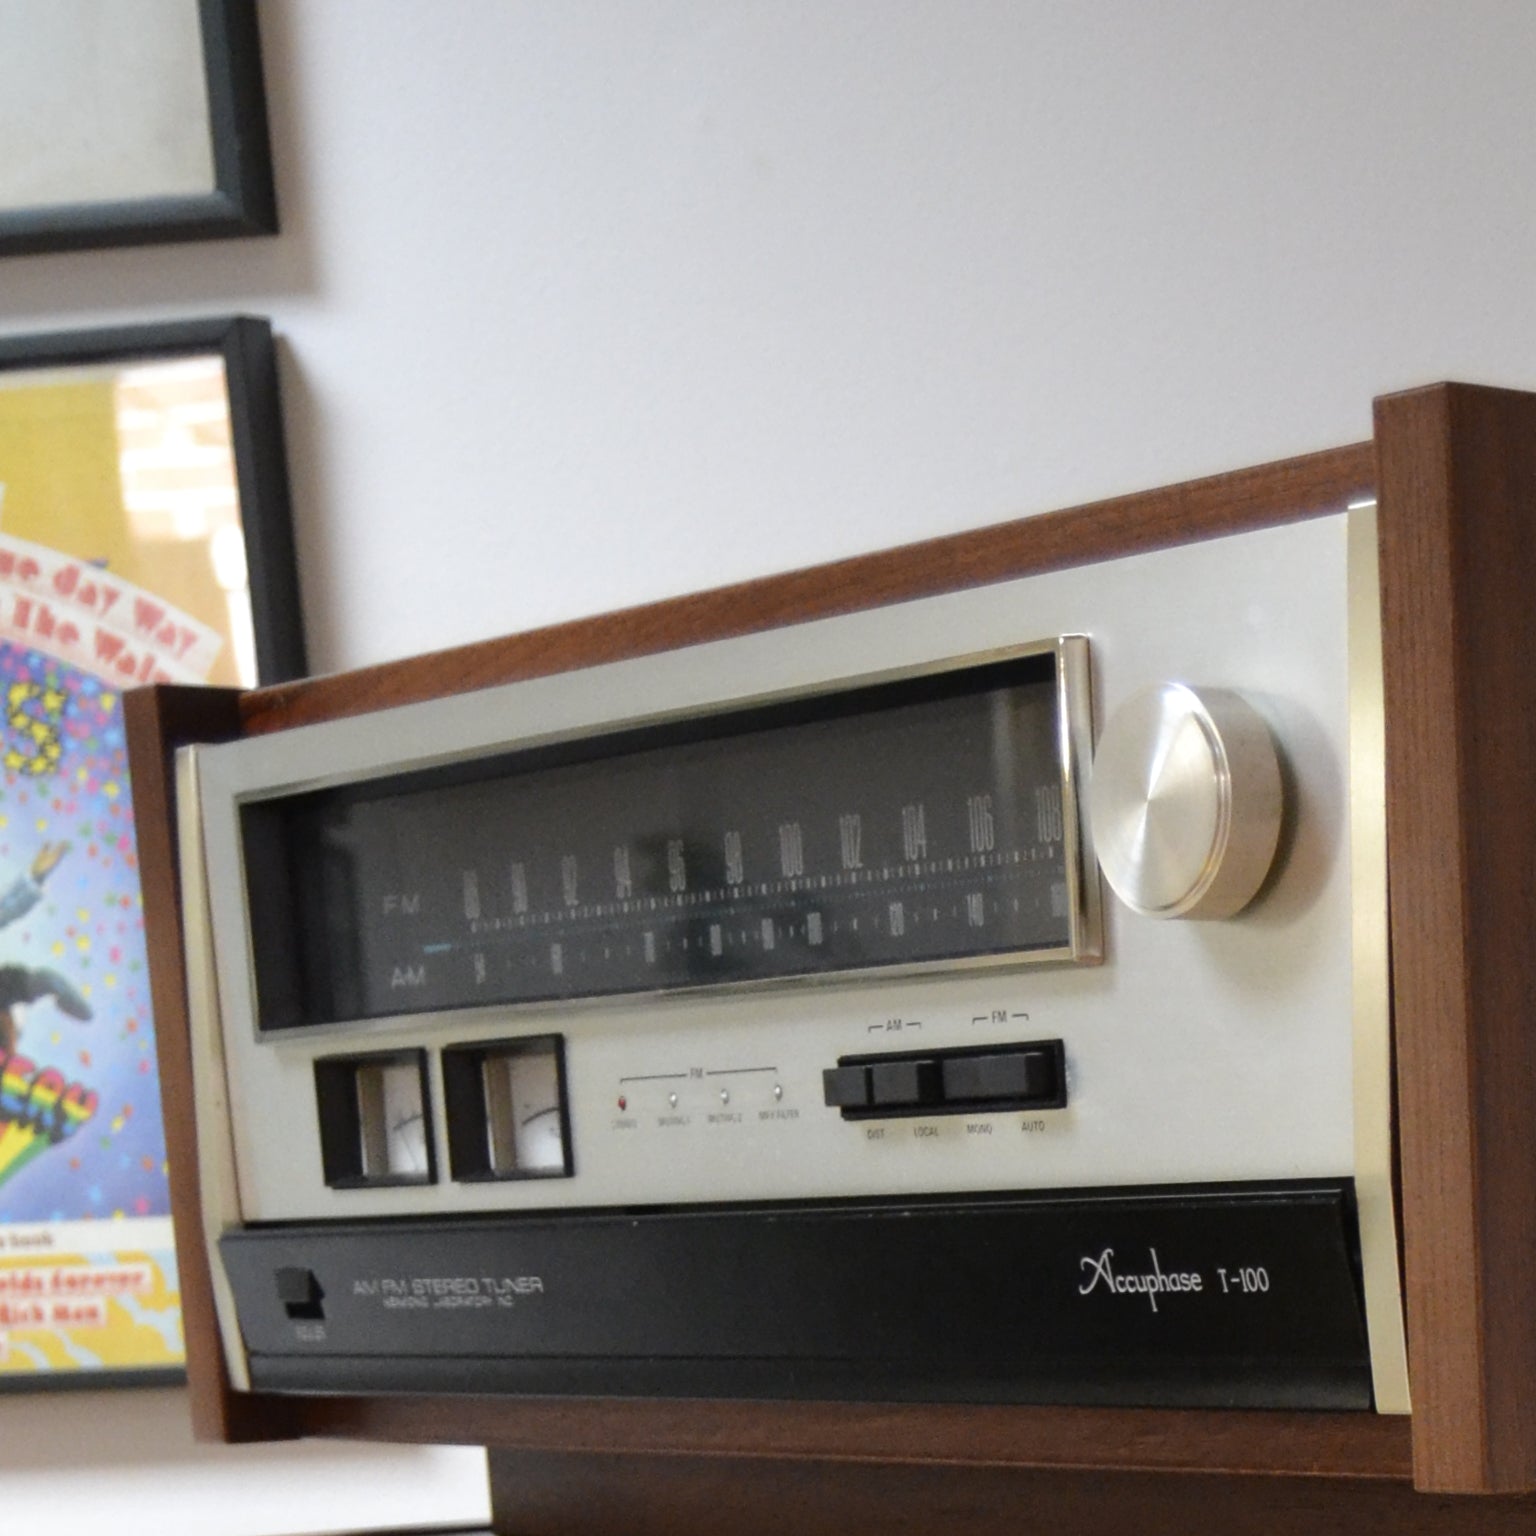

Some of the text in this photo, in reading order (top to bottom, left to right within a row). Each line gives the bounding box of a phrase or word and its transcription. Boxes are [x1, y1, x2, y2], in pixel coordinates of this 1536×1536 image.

[967, 794, 995, 852] 106
[1035, 784, 1063, 843] 108
[902, 803, 927, 861] 104
[383, 894, 420, 914] FM
[391, 966, 427, 989] AM
[885, 1018, 903, 1032] AM
[991, 1009, 1008, 1024] FM
[1021, 1120, 1046, 1133] AUTO
[412, 1278, 479, 1295] STEREO
[481, 1276, 545, 1294] TUNER
[1078, 1248, 1269, 1313] Accuphase T-100
